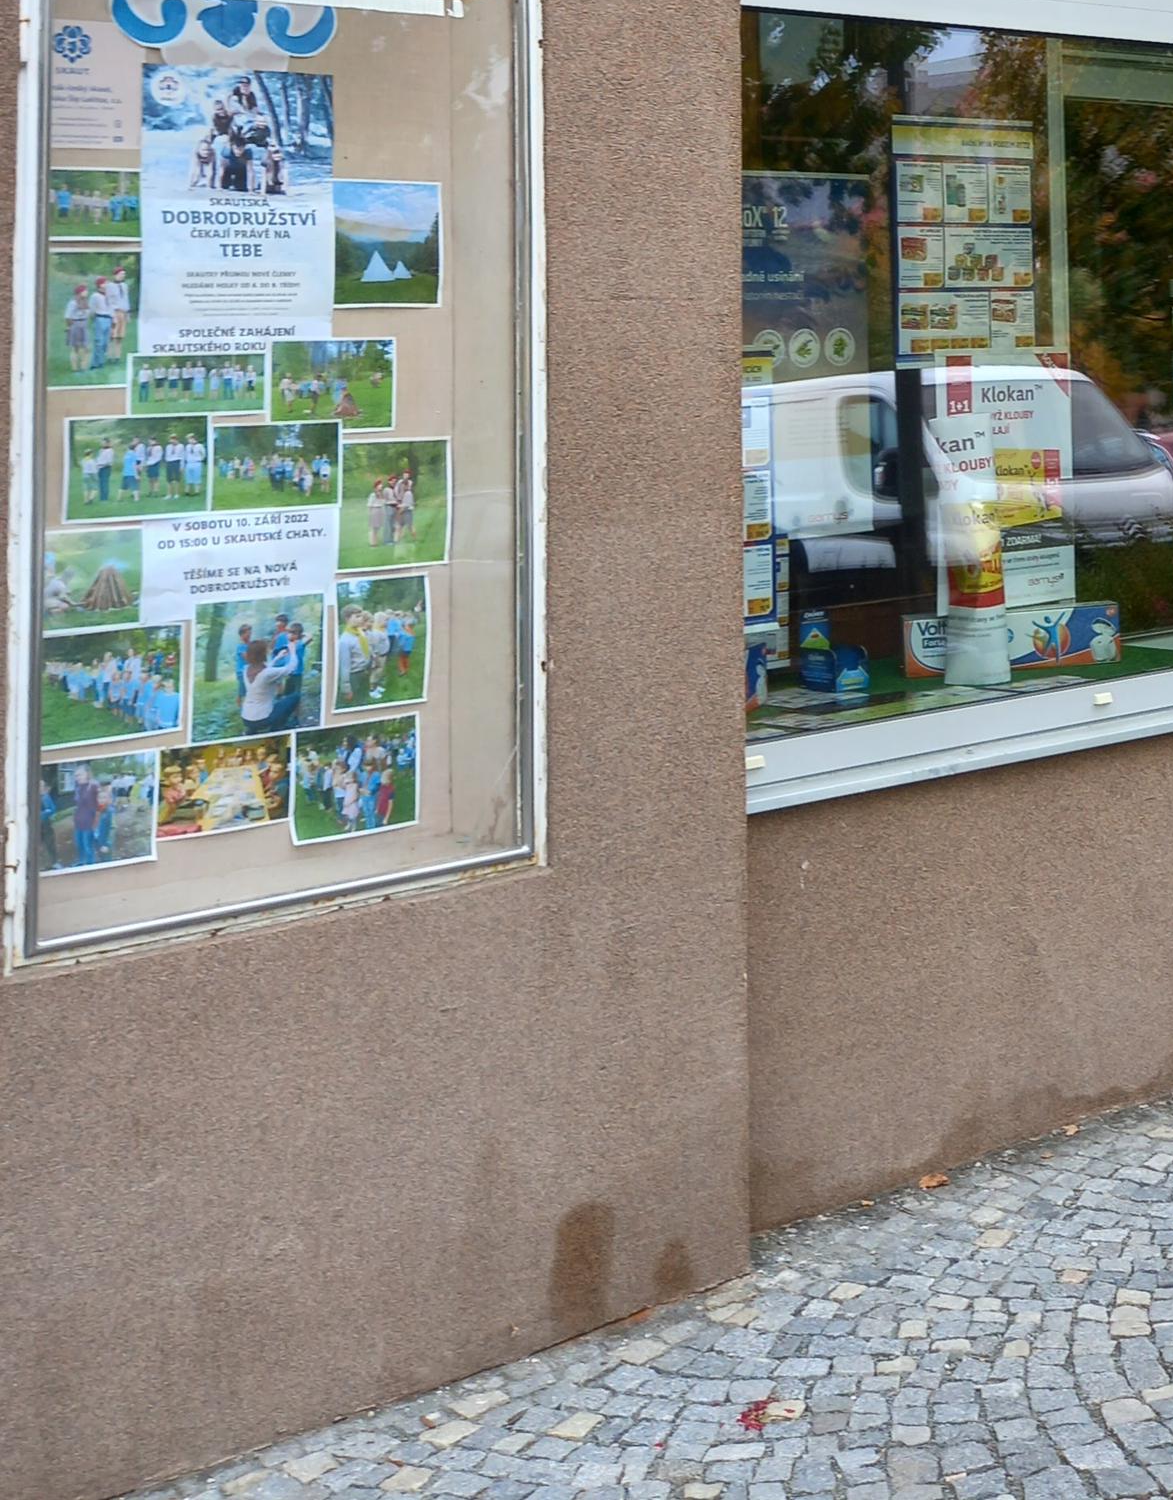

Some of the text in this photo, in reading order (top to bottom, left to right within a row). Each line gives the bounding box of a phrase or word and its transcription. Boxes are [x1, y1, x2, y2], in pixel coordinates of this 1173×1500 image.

[162, 209, 317, 226] DOBRODRUŽSTVÍ
[190, 227, 231, 239] ČEKAJÍ
[274, 230, 291, 239] NA
[219, 244, 263, 257] TEBE
[179, 325, 295, 338] SPOLEČNÉ ZAHÁJENÍ
[152, 342, 266, 353] SKAUTSKÉHO ROKU
[949, 400, 971, 412] 1+1
[172, 514, 309, 532] V SOBOTU 10. ZÁŘÍ 2022
[158, 540, 175, 549] OD
[179, 539, 208, 548] 15:00
[212, 536, 220, 546] U
[224, 532, 283, 544] SKAUTSKÉ
[184, 560, 298, 580] TĚŠÍME SE NA NOVÁ
